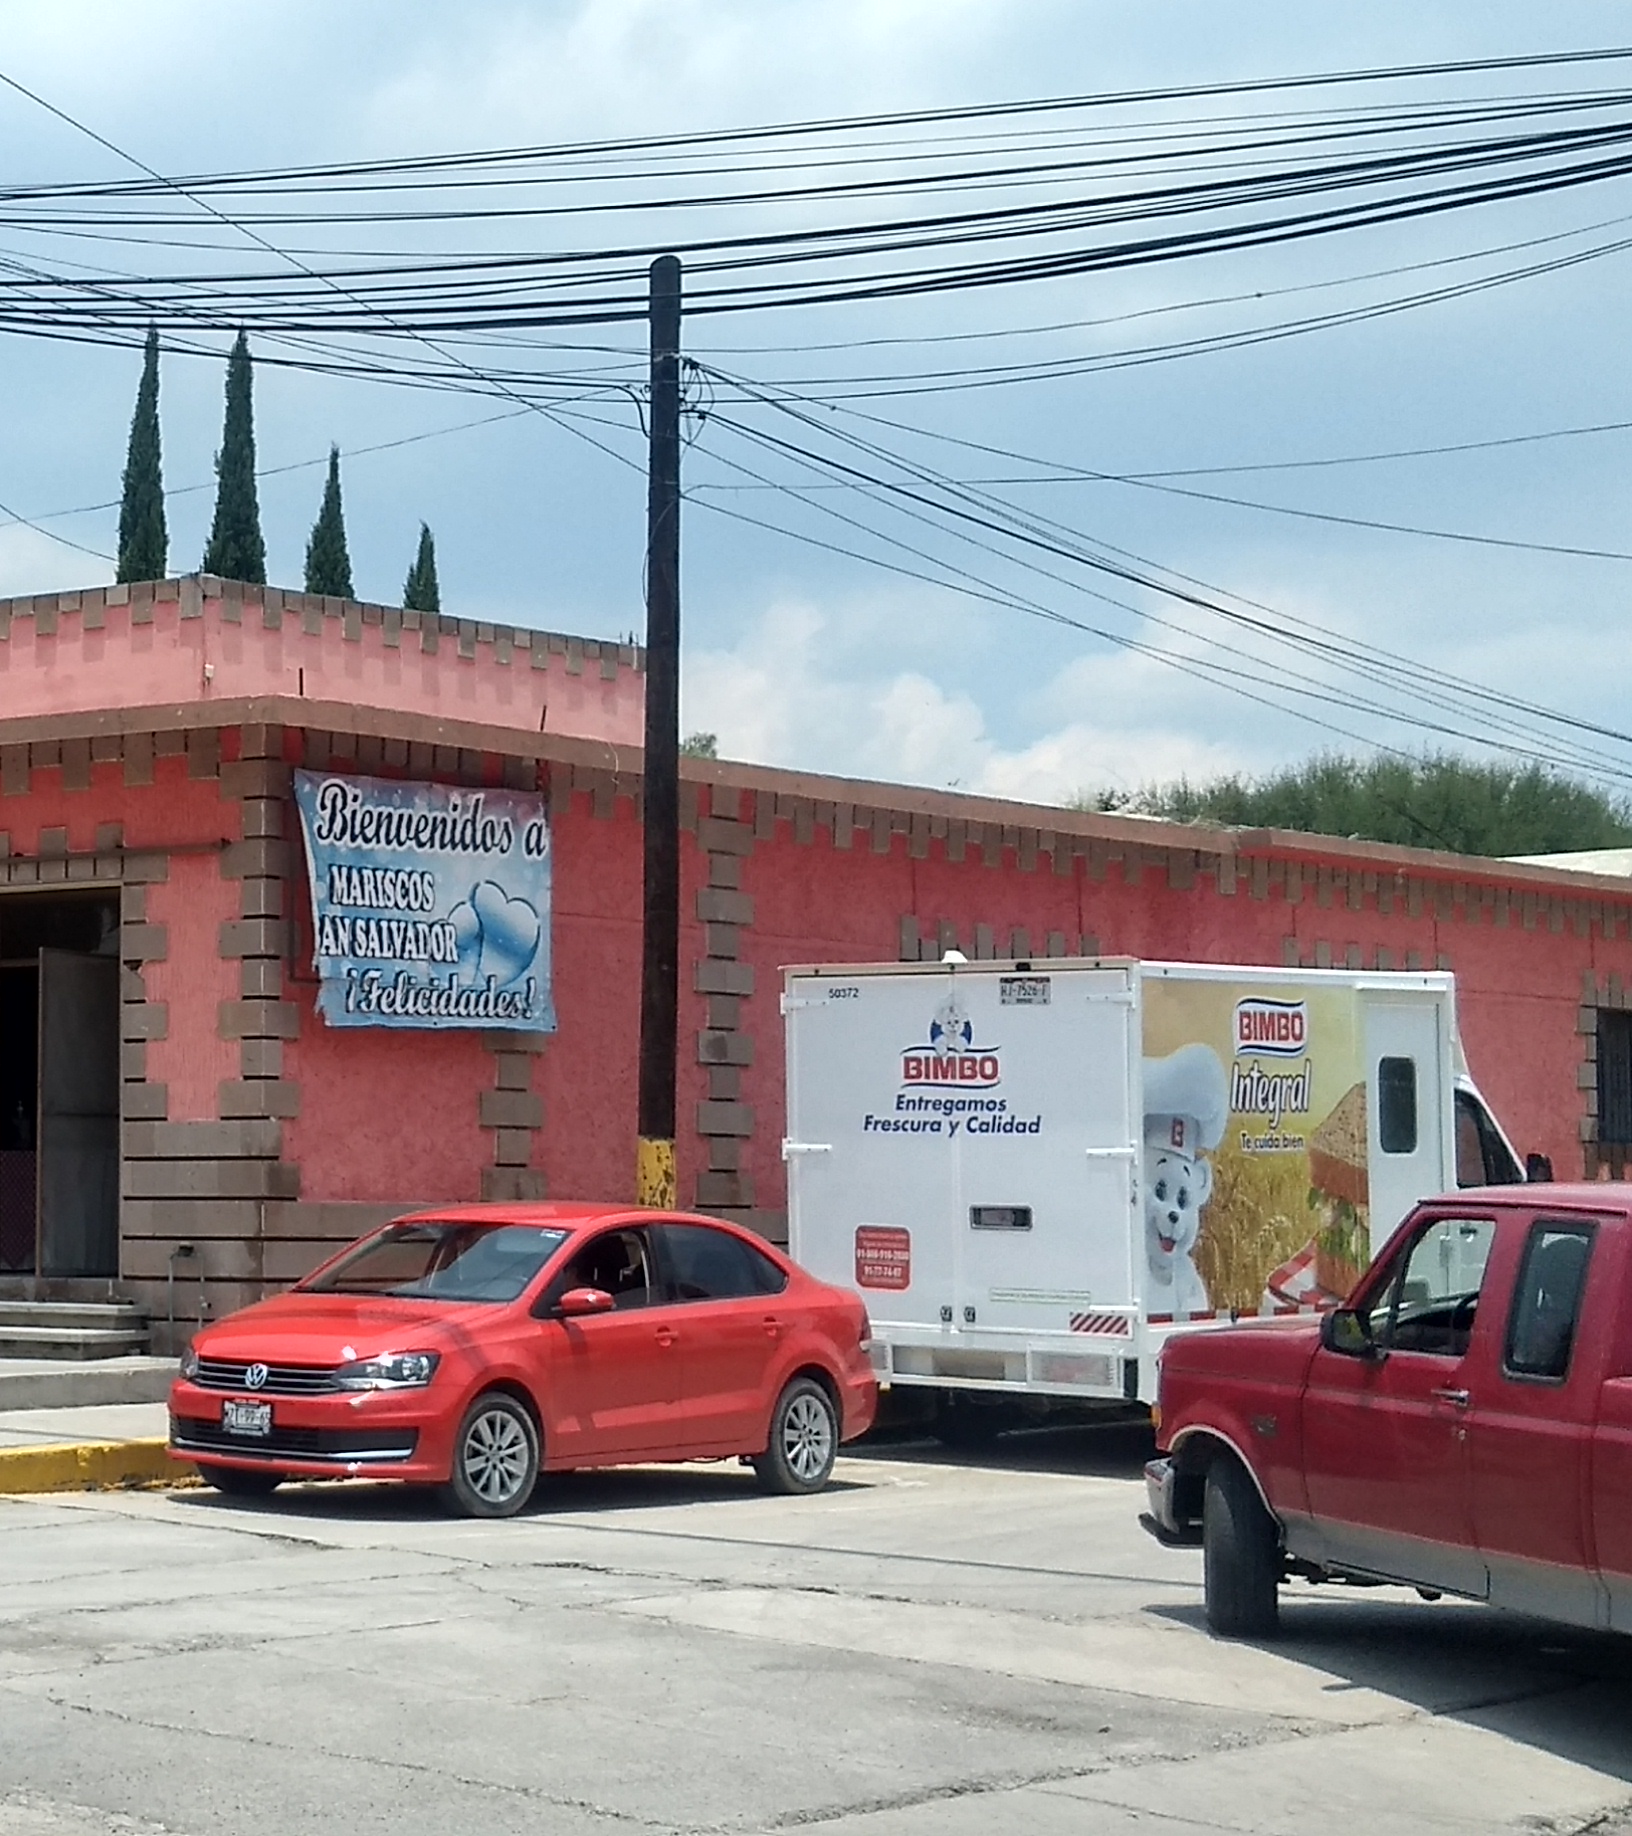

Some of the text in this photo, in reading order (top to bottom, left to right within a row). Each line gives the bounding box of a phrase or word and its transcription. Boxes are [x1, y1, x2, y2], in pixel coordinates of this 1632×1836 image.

[317, 783, 547, 857] Bienvenidos a
[329, 865, 434, 912] MARISCOS
[353, 918, 459, 963] SALVADOR
[828, 988, 859, 999] 50372
[1238, 1010, 1304, 1042] BIMBO
[903, 1055, 999, 1081] BIMBO
[895, 1094, 1008, 1117] Entregamos
[1230, 1058, 1311, 1130] Integral
[863, 1115, 1042, 1139] Frescura y Calidad
[1241, 1132, 1304, 1149] Te cuida bien
